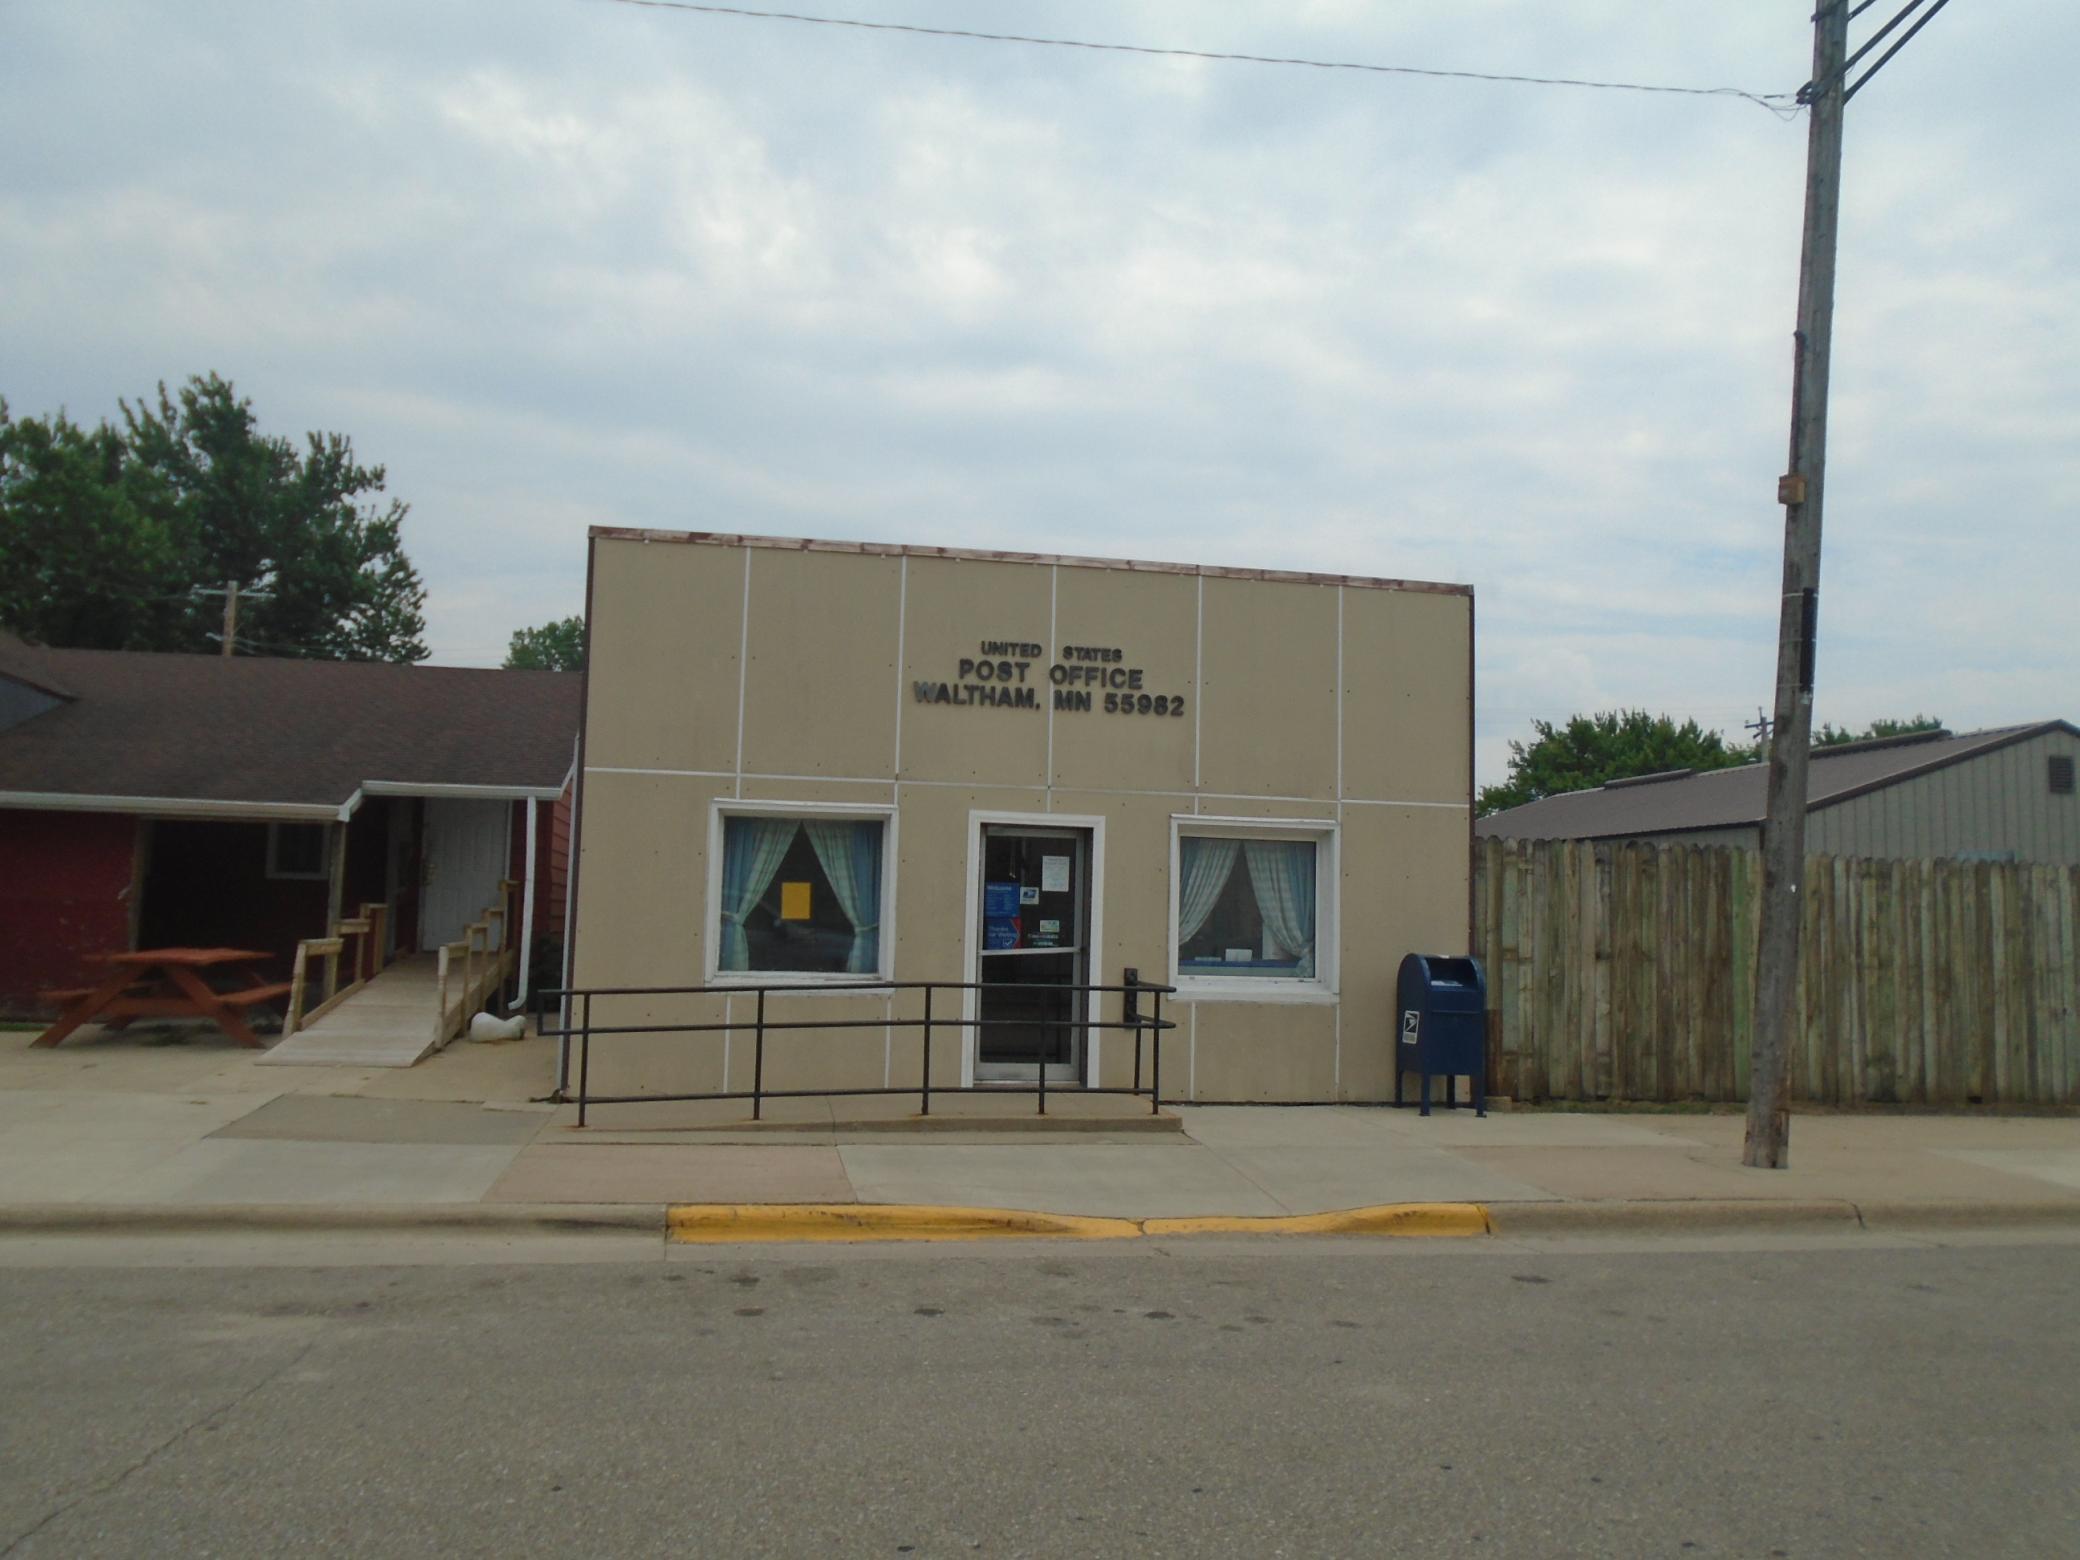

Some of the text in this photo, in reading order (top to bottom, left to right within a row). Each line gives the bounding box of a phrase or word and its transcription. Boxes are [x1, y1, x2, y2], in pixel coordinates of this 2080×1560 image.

[981, 641, 1122, 662] UNITED STATES
[958, 658, 1143, 690] POST OFFICE
[1054, 689, 1091, 712] MN
[1104, 692, 1184, 717] 55982
